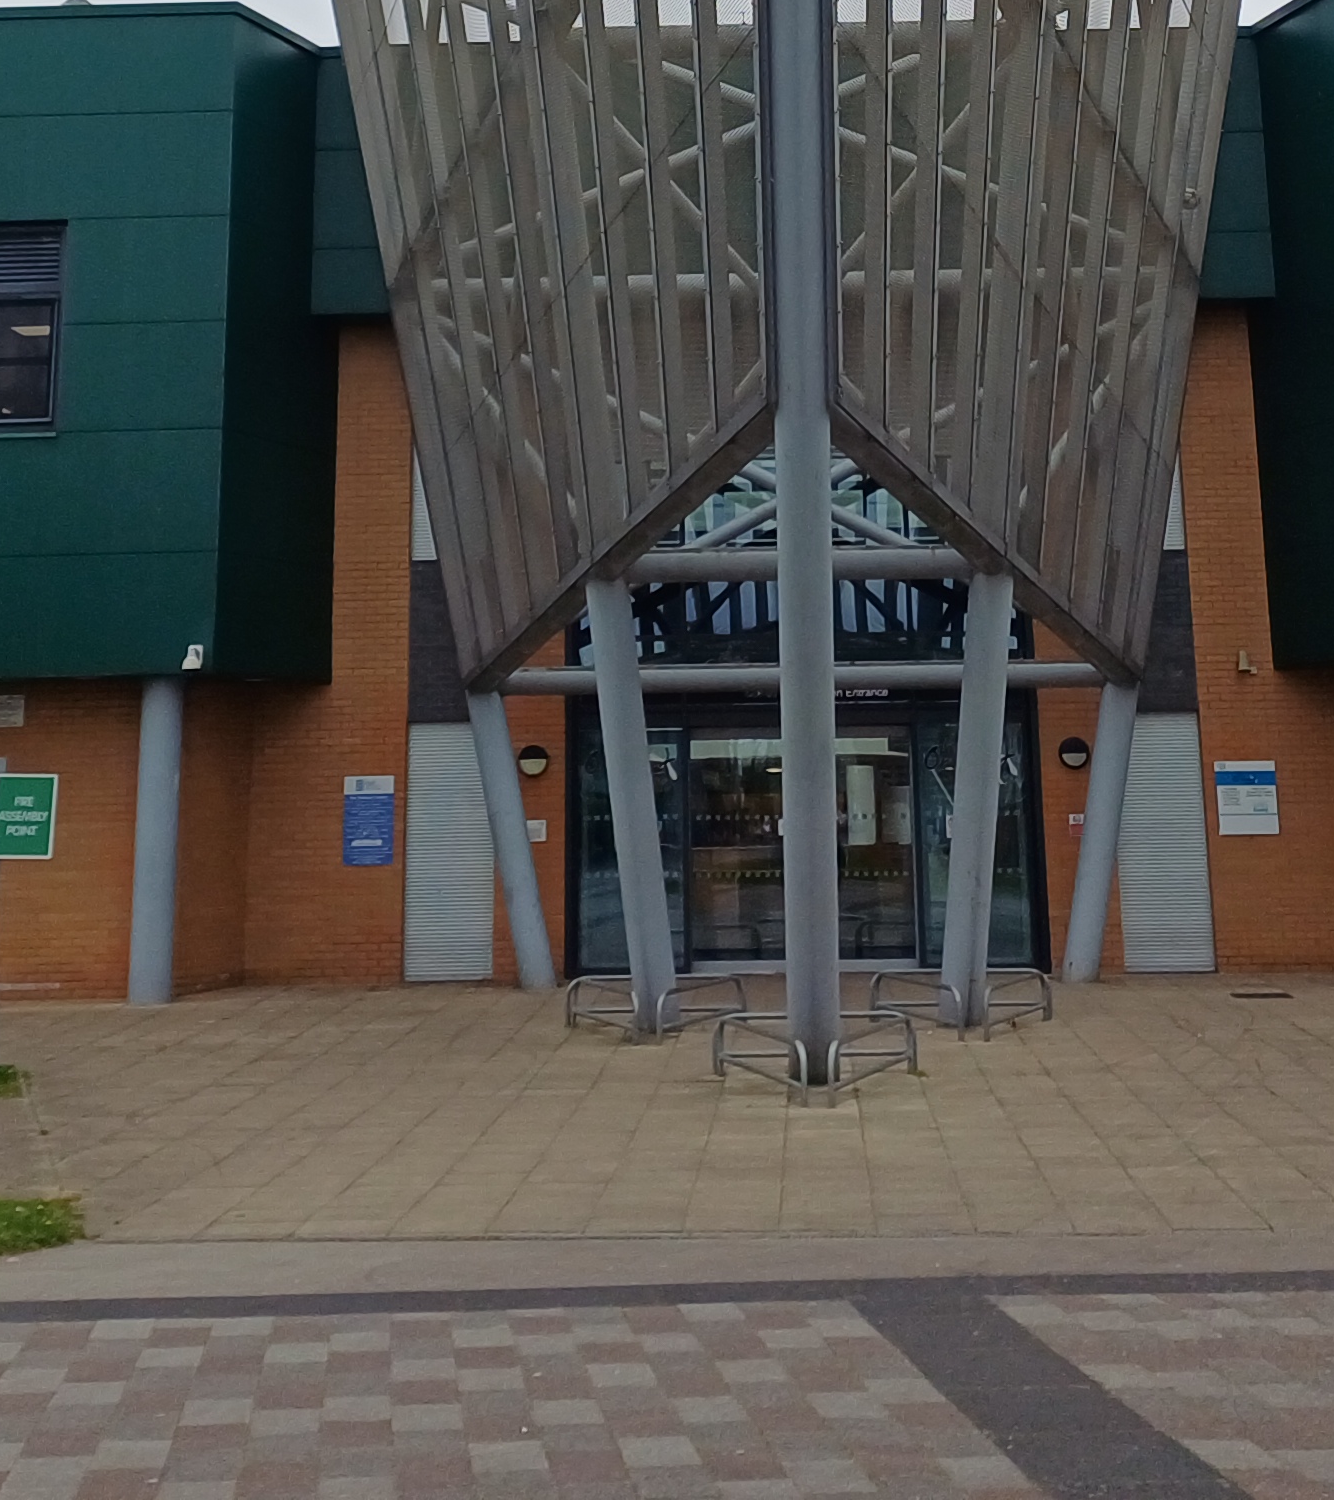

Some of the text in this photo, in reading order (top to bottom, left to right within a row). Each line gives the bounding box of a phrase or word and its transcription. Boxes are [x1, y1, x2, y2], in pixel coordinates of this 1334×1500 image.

[846, 689, 888, 697] Entrance
[14, 796, 34, 807] FIRE
[6, 826, 38, 836] POINT
